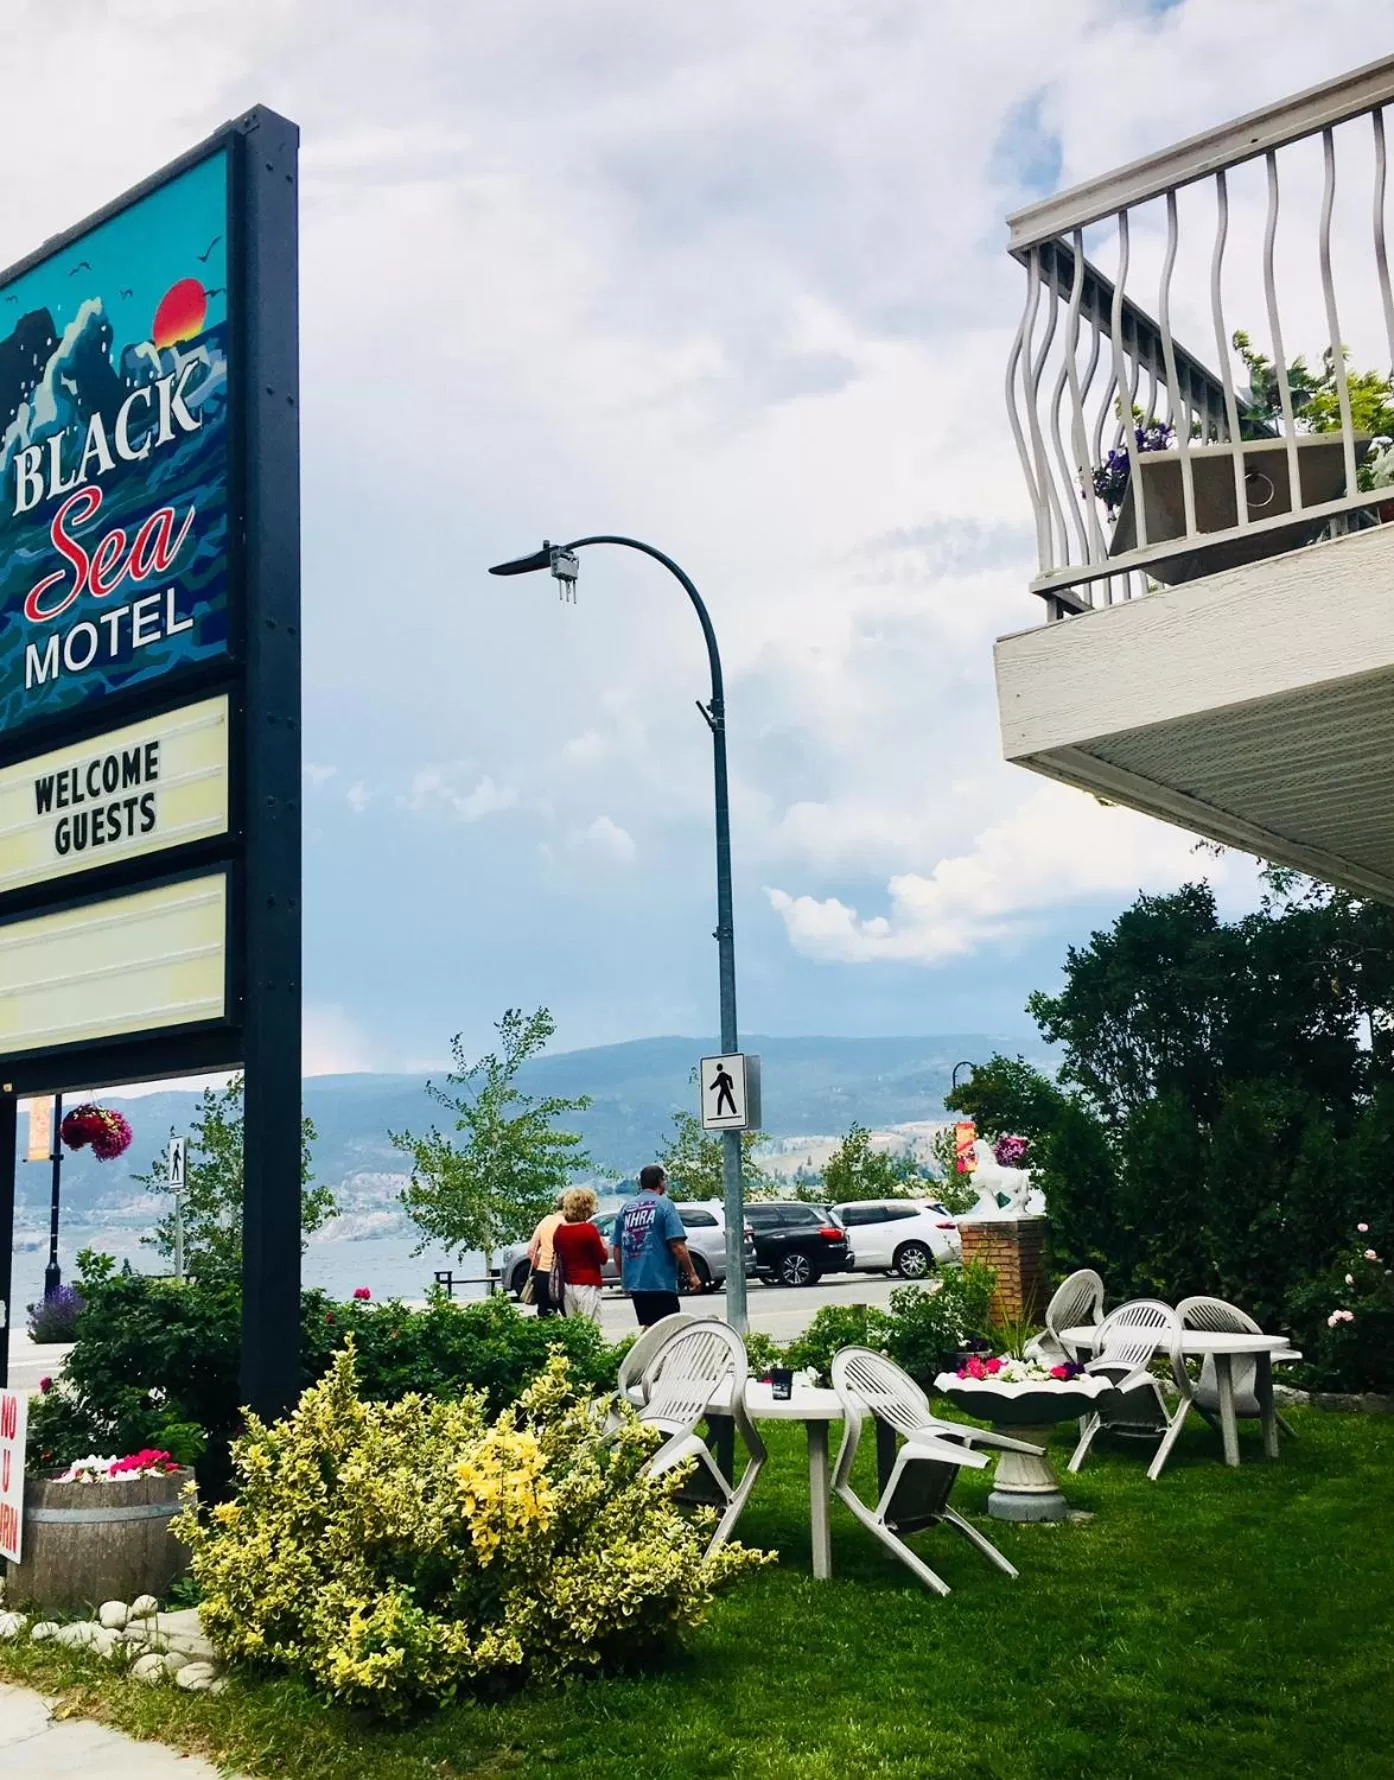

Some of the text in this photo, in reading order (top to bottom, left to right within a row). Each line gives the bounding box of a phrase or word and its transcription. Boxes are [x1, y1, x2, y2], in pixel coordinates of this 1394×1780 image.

[13, 359, 203, 516] BLACK
[24, 484, 195, 623] Sea
[24, 587, 194, 690] MOTEL
[35, 740, 159, 815] WELCOME
[55, 792, 156, 855] GUESTS
[624, 1209, 656, 1231] NHRA
[0, 1394, 18, 1440] NO
[3, 1448, 11, 1493] U
